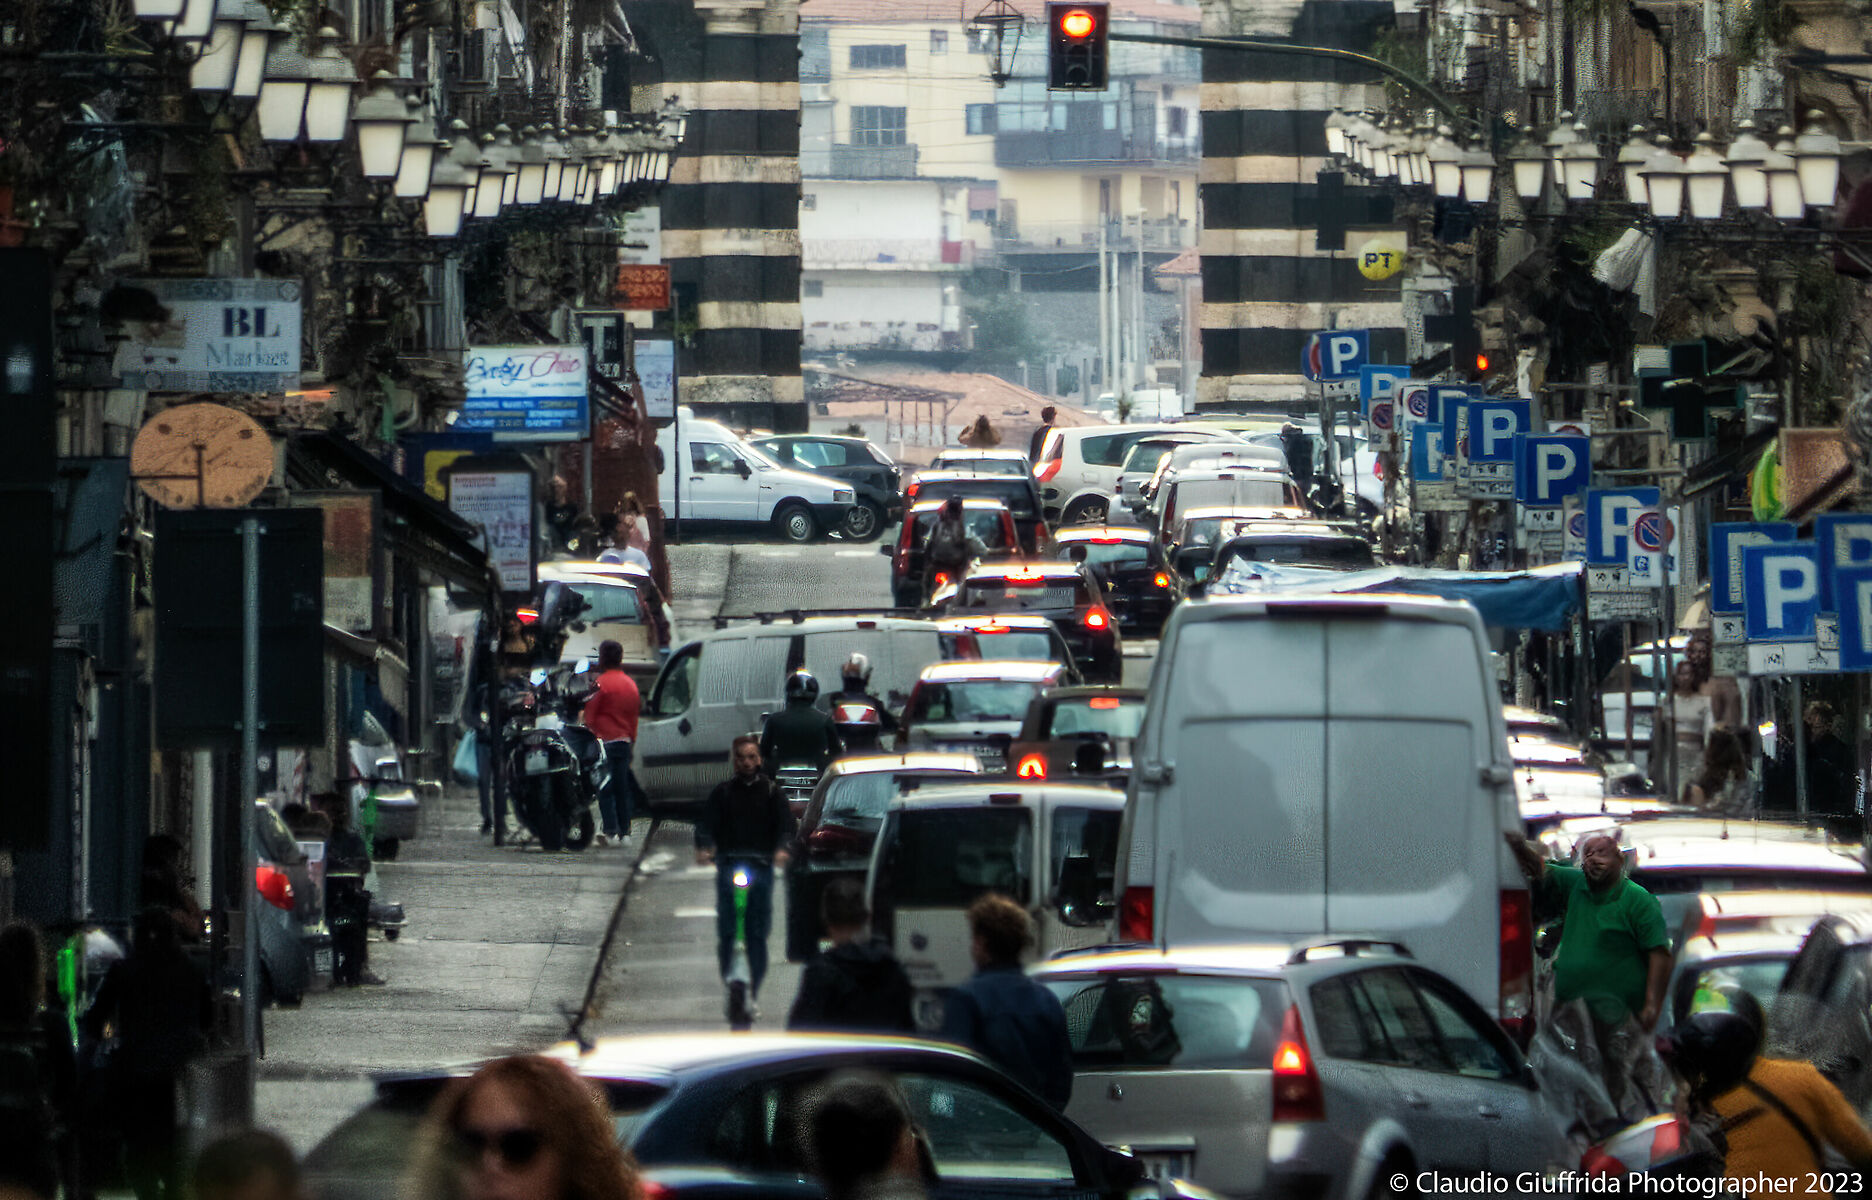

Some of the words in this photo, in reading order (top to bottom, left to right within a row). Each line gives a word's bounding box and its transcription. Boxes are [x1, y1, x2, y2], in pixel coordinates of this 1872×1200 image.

[1365, 253, 1393, 268] PT
[224, 307, 280, 337] BL
[1330, 336, 1359, 375] P
[1482, 409, 1517, 456] P
[1536, 444, 1577, 499] P
[1763, 556, 1818, 629] P
